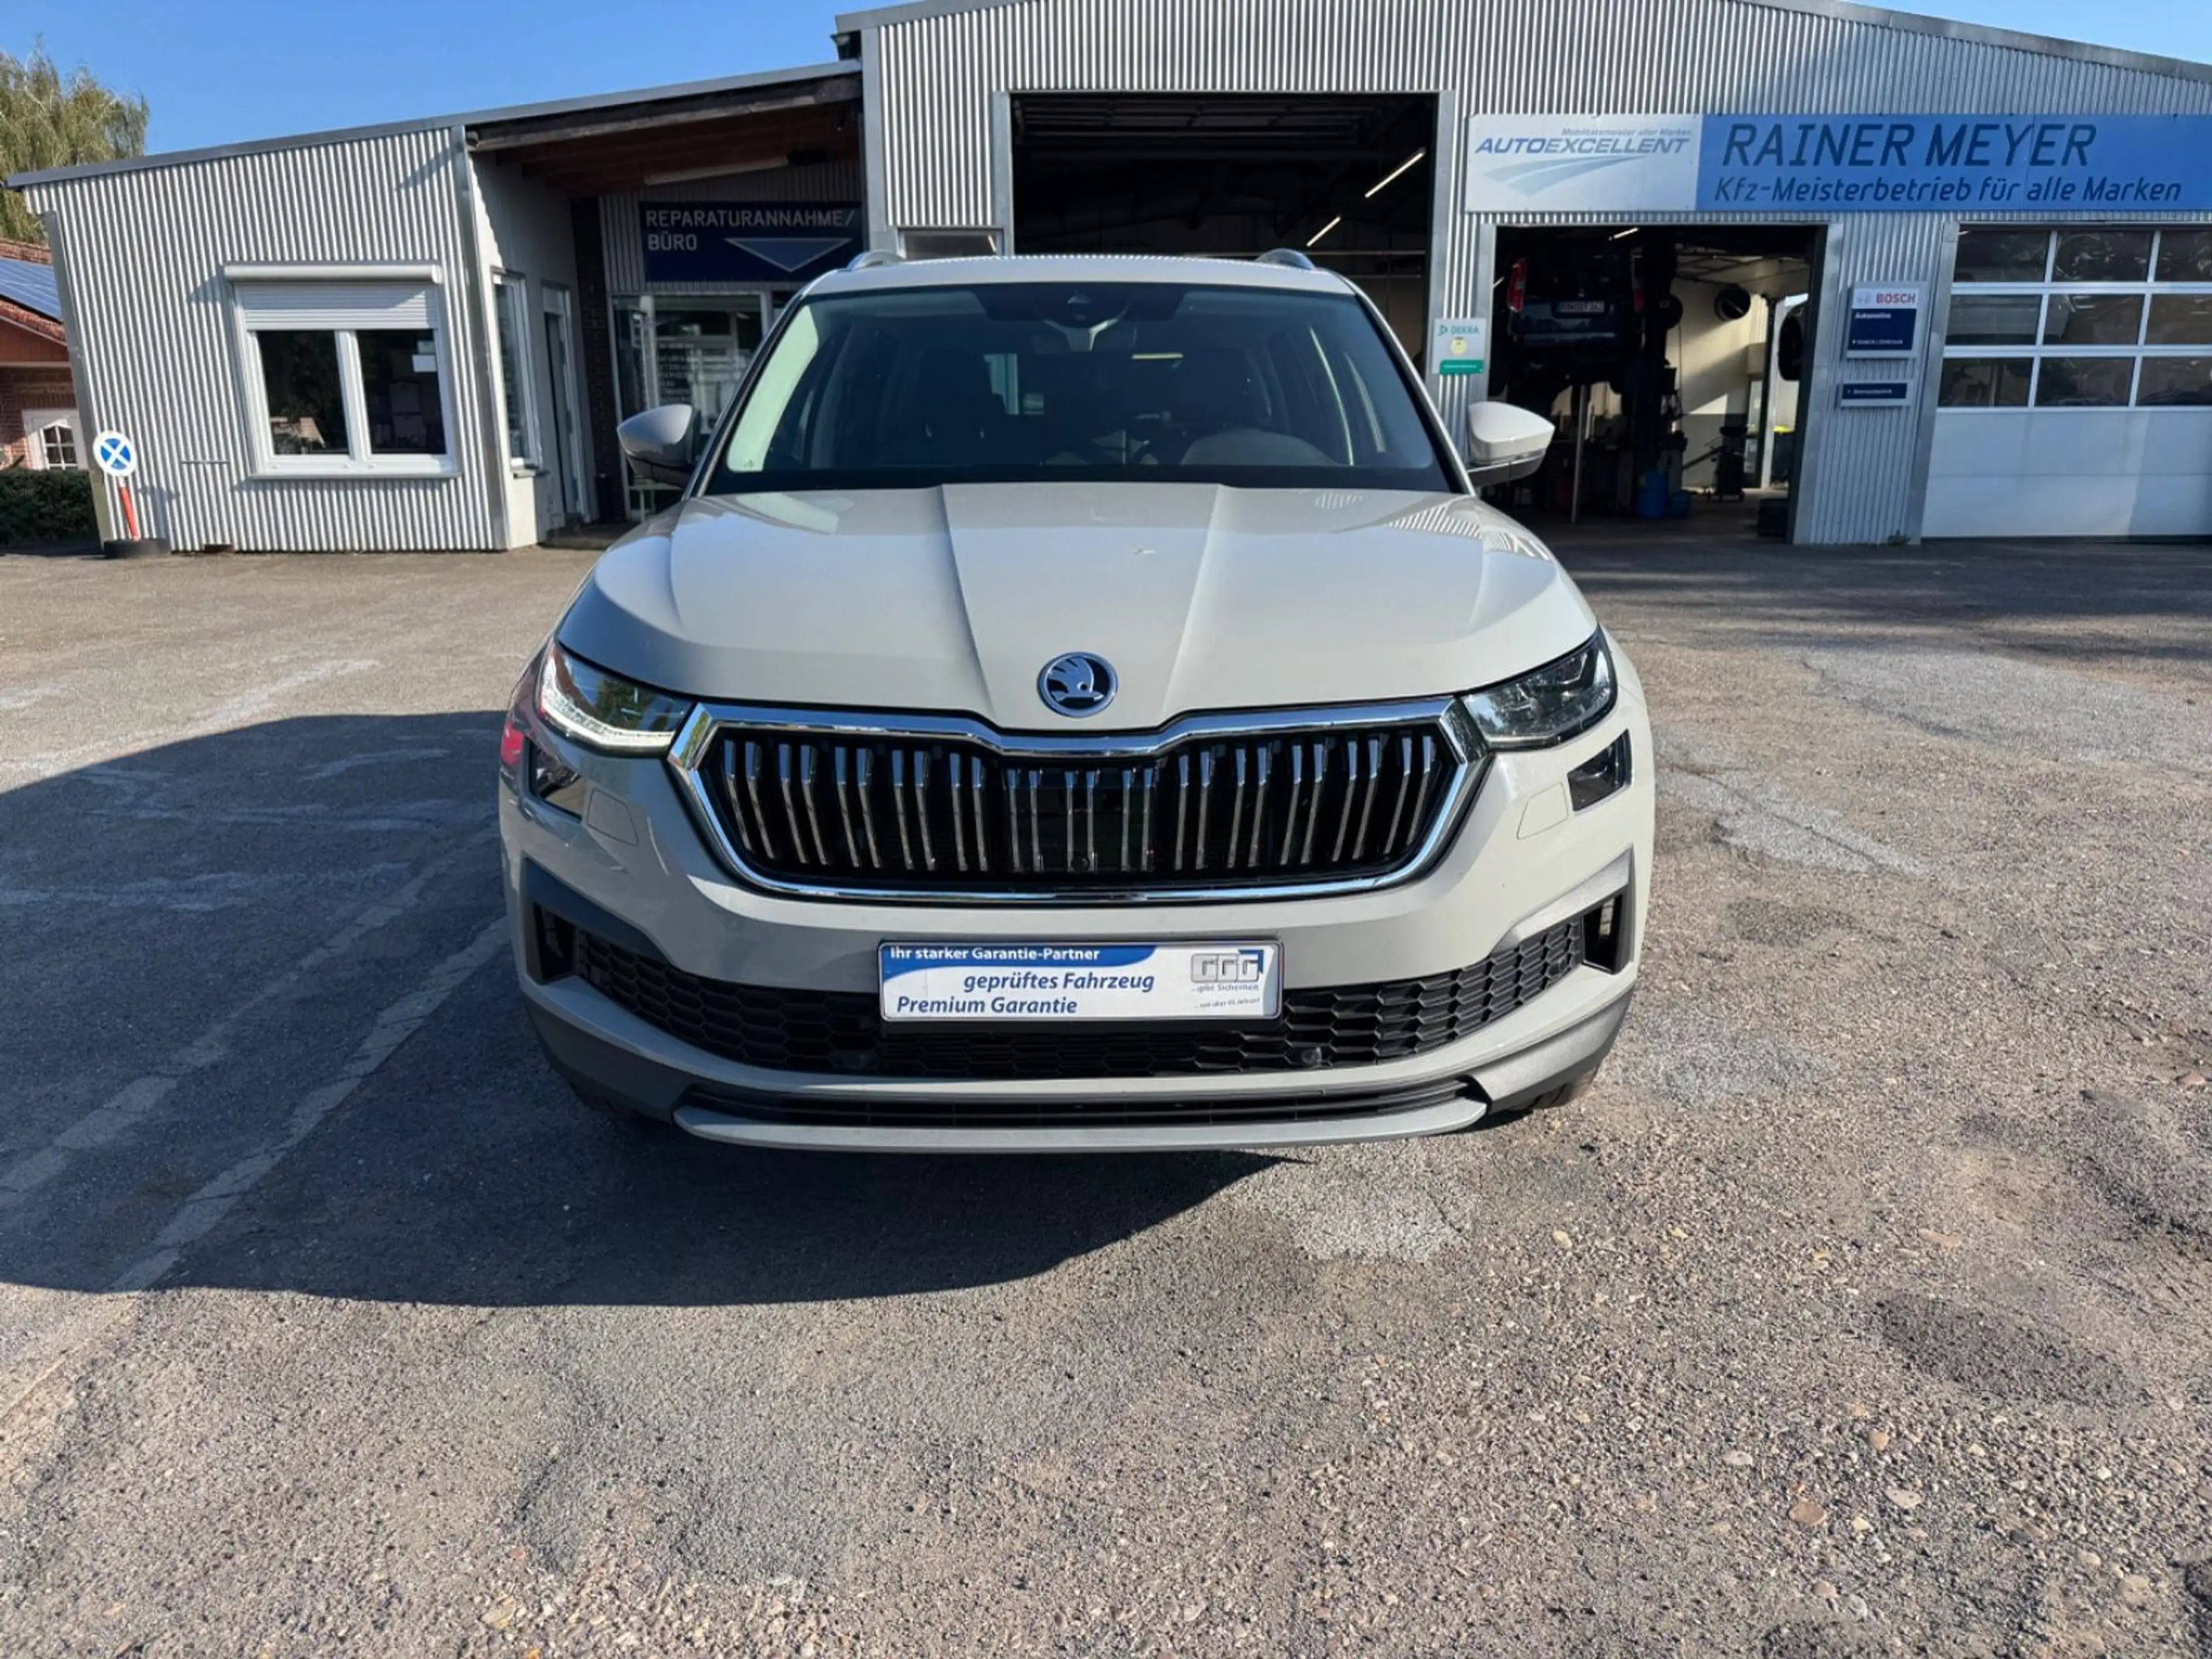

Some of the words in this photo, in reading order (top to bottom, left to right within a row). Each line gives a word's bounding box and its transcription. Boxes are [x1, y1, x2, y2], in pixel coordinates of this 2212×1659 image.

[1475, 138, 1690, 154] AUTOEXCELLENT
[1722, 123, 1915, 167] RAINER
[1925, 123, 2097, 167] MEYER
[1714, 176, 1971, 202] Kfz-Meisterbetrieb
[1978, 176, 2020, 202] für
[2026, 176, 2076, 202] alle
[2082, 176, 2182, 202] Marken
[646, 210, 855, 228] REPARATURANNAHME/
[647, 230, 698, 251] BÜRO
[1876, 293, 1915, 304] BOSCH
[890, 946, 911, 960] Ihr
[915, 946, 969, 960] starker
[971, 946, 1101, 961] Garantie-Partner
[964, 971, 1058, 993] geprüftes
[1063, 971, 1155, 993] Fahrzeug
[897, 995, 986, 1014] Premium
[990, 996, 1078, 1014] Garantie
